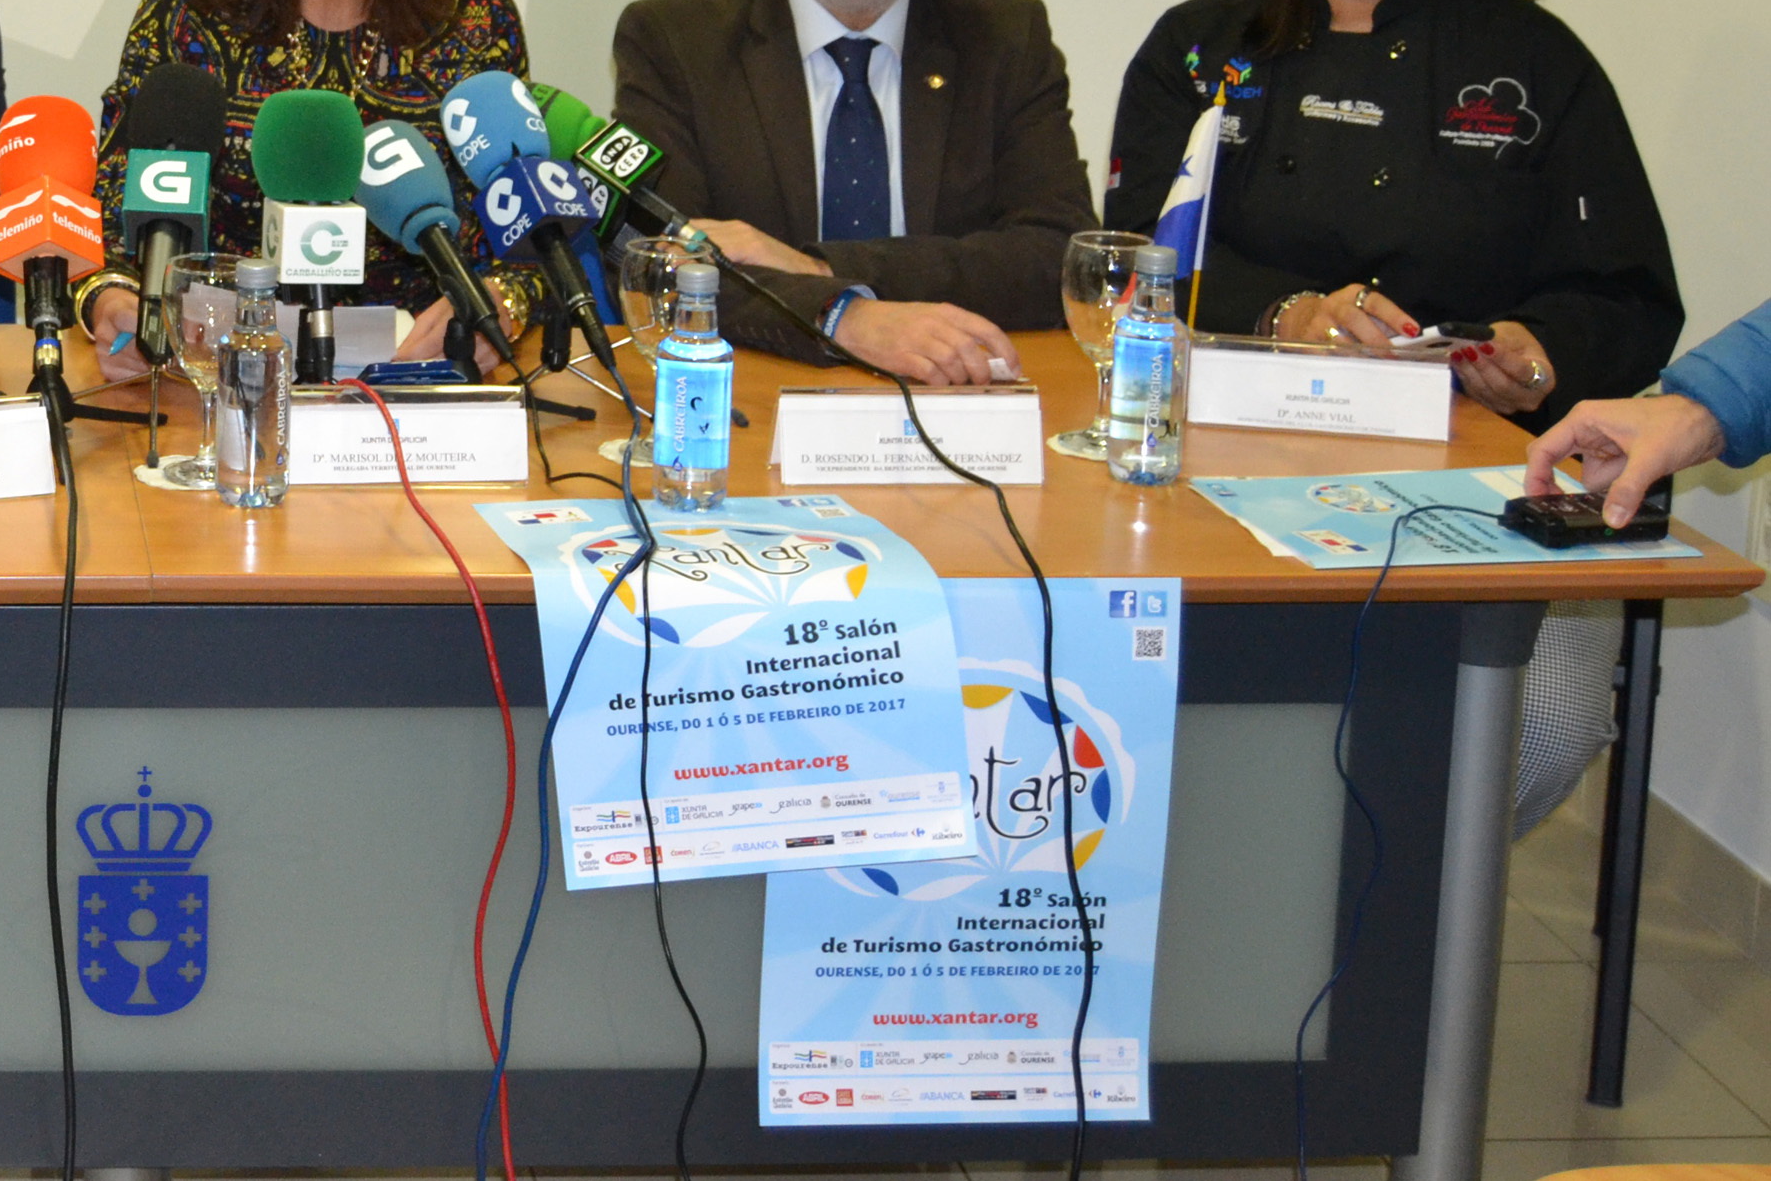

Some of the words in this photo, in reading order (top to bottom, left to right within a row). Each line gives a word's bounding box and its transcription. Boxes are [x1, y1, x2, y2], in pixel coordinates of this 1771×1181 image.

[458, 134, 491, 167] COPE
[602, 137, 632, 165] ONDA
[618, 147, 645, 173] CERO
[554, 201, 588, 217] COPE
[52, 212, 102, 245] telemiño
[502, 213, 533, 246] COPE
[285, 266, 342, 277] CARBALLIÑO
[1295, 410, 1326, 421] ANNE
[1328, 413, 1356, 423] VIAL
[330, 453, 382, 464] MARISOL
[415, 452, 477, 463] MOUTEIRA
[801, 455, 812, 464] D.
[815, 454, 869, 464] ROSENDO
[872, 454, 882, 464] L.
[955, 450, 1022, 464] FERNÁNDEZ
[783, 619, 829, 647] 18º
[834, 617, 898, 640] Salón
[745, 640, 902, 676] Internacional
[608, 693, 637, 713] de
[740, 667, 905, 701] Gastronómico
[706, 717, 716, 730] 1
[718, 710, 731, 729] Ó
[733, 714, 742, 727] 5
[746, 712, 767, 726] DE
[769, 703, 842, 723] FEBREIRO
[845, 701, 866, 716] DE
[869, 698, 907, 716] 2017
[673, 751, 850, 782] www.xantar.org
[682, 805, 708, 813] XUNTA
[836, 798, 872, 807] OURENSE
[693, 811, 723, 820] GALICIA
[574, 822, 633, 833] Expourense
[736, 840, 779, 853] ABANCA
[997, 888, 1043, 908] 18º
[821, 938, 848, 955] de
[853, 938, 942, 955] Turismo
[815, 966, 884, 979] OURENSE,
[910, 967, 917, 977] 1
[922, 963, 933, 977] Ó
[937, 966, 945, 977] 5
[948, 966, 967, 977] DE
[970, 965, 1039, 977] FEBREIRO
[1043, 966, 1062, 977] DE
[872, 1009, 1039, 1029] www.xantar.org
[771, 1062, 828, 1070] Expourense
[923, 1092, 964, 1101] ABANCA
